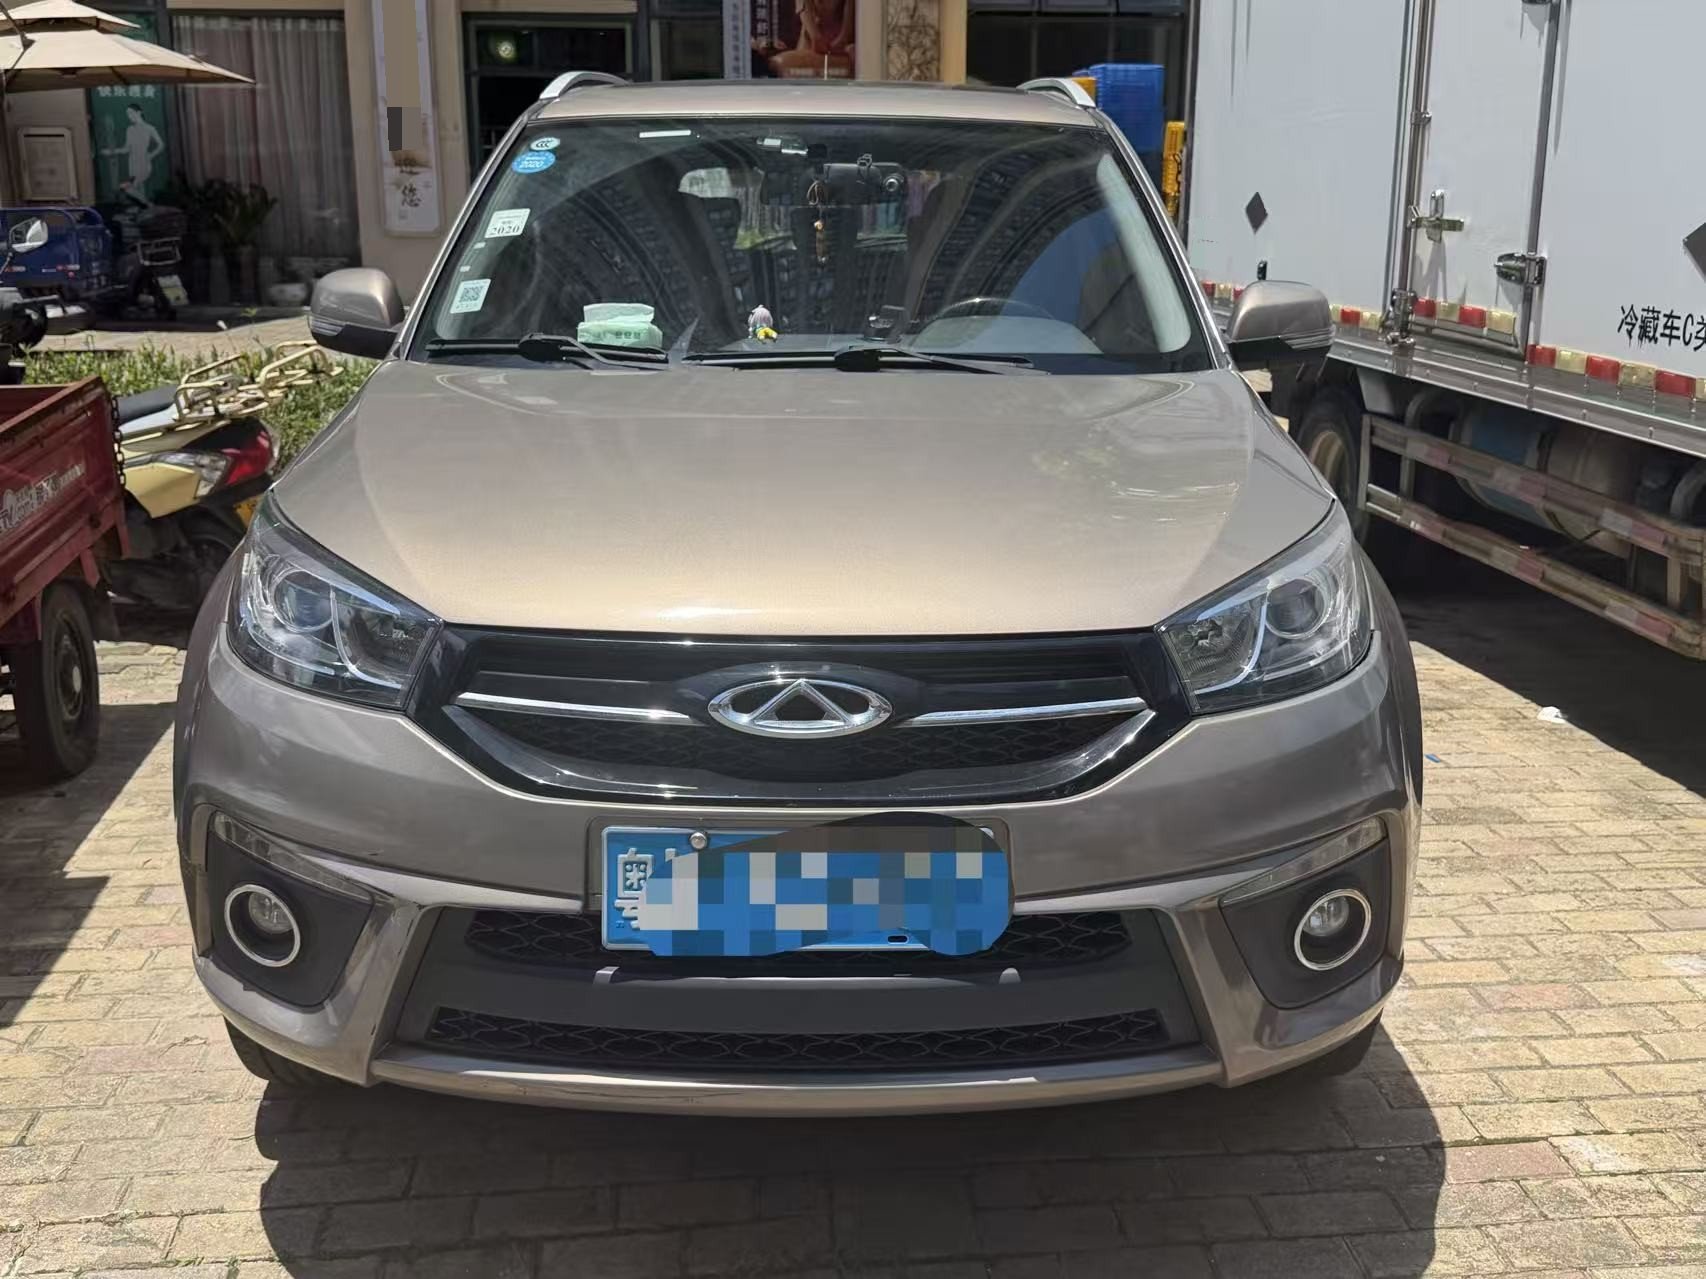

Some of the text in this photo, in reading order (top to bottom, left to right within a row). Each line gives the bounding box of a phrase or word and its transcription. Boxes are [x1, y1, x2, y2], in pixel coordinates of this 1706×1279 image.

[489, 225, 520, 236] 2020
[1617, 304, 1706, 351] 冷藏车C类
